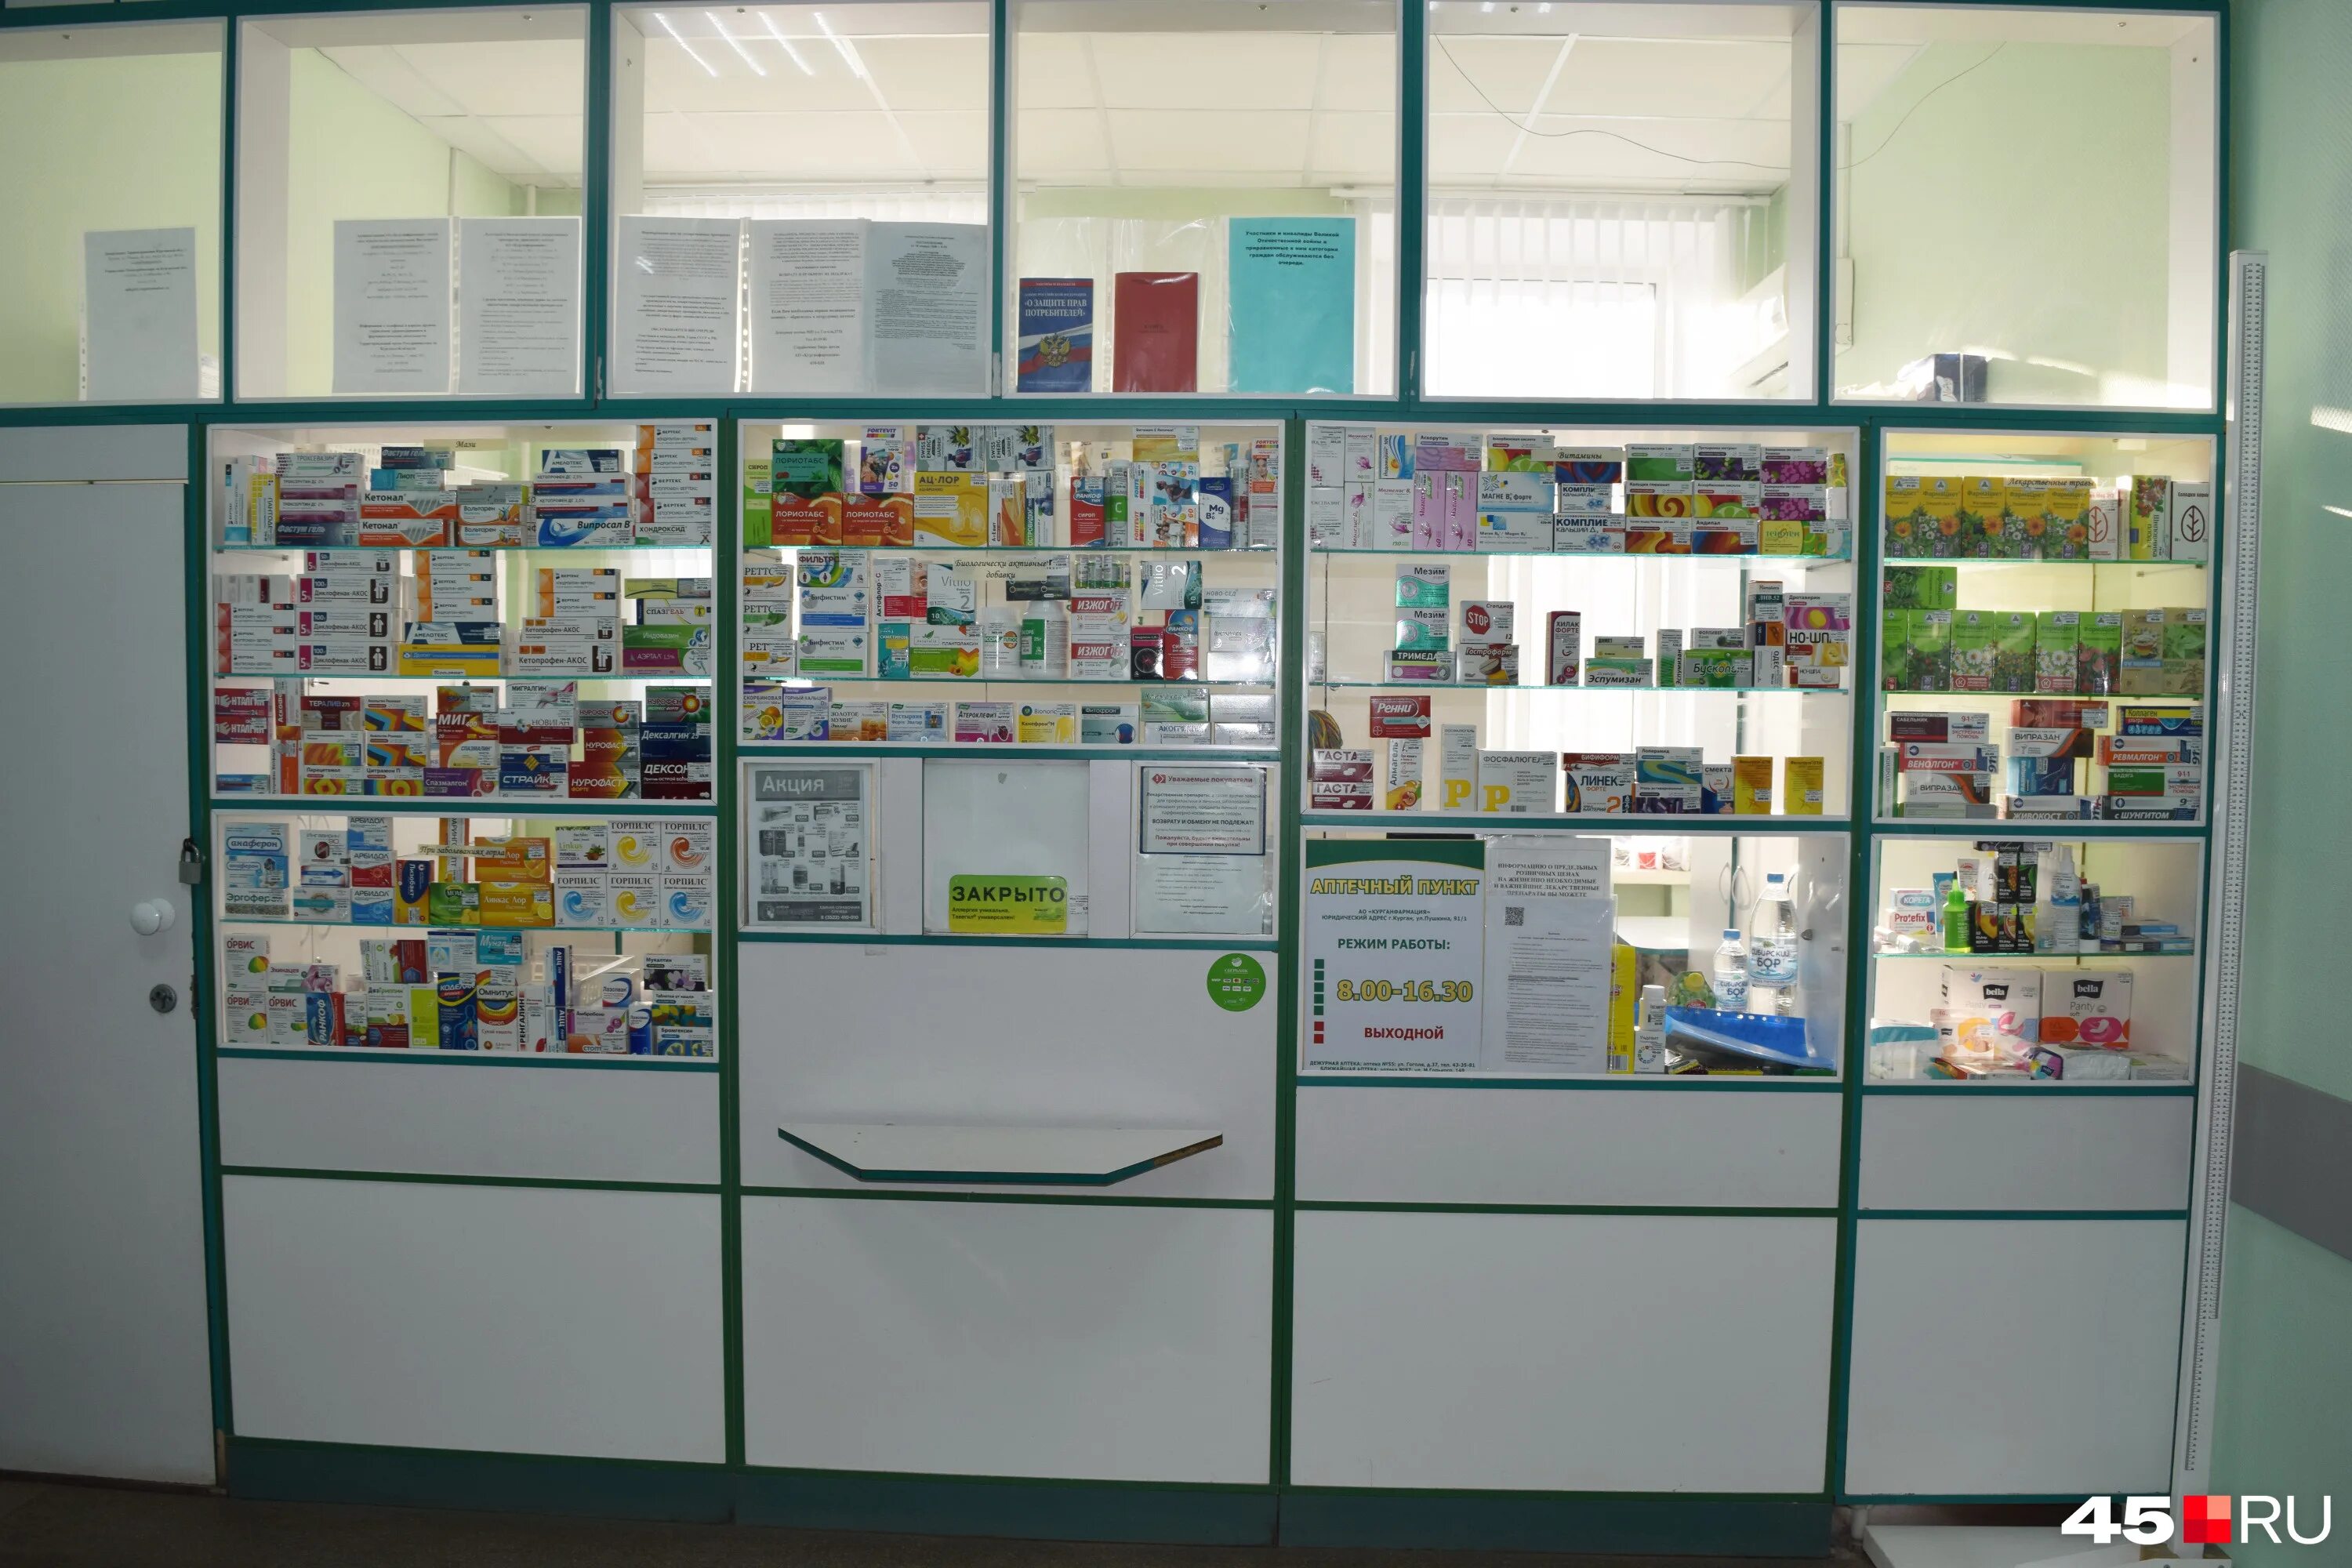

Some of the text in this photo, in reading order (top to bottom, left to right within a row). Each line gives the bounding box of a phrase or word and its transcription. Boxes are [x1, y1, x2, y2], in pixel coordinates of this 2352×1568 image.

[456, 441, 476, 449] Мази
[775, 457, 824, 466] ЛОРИОТАБС
[2009, 477, 2069, 489] Лекарственные
[365, 493, 405, 503] Кетонал
[363, 521, 398, 530] Кетонал
[577, 521, 623, 530] Випросал
[1414, 610, 1445, 619] Мезим
[1468, 612, 1489, 627] STOP
[1588, 675, 1641, 684] Эспумизан
[1377, 702, 1412, 713] Ренни
[438, 714, 470, 725] МИГ
[641, 731, 688, 740] Дексалгин
[1389, 742, 1398, 786] Алмагель
[572, 779, 622, 787] НУРОФАСТ
[763, 775, 825, 793] Акция
[612, 822, 655, 830] ГОРПИЛС
[230, 839, 278, 848] анаферон
[419, 846, 505, 858] При заболеваниях горла
[665, 877, 706, 886] ГОРПИЛС
[1310, 875, 1479, 895] АПТЕЧНЫЙ ПУНКТ
[952, 886, 1065, 902] ЗАКРЫТО
[1894, 913, 1926, 923] Protefix
[1338, 938, 1451, 950] РЕЖИМ РАБОТЫ:
[478, 989, 514, 998] Омнитус
[1337, 979, 1473, 1003] 8.00-16.30
[2070, 1002, 2095, 1013] Panty
[1364, 1026, 1444, 1041] ВЫХОДНОЙ
